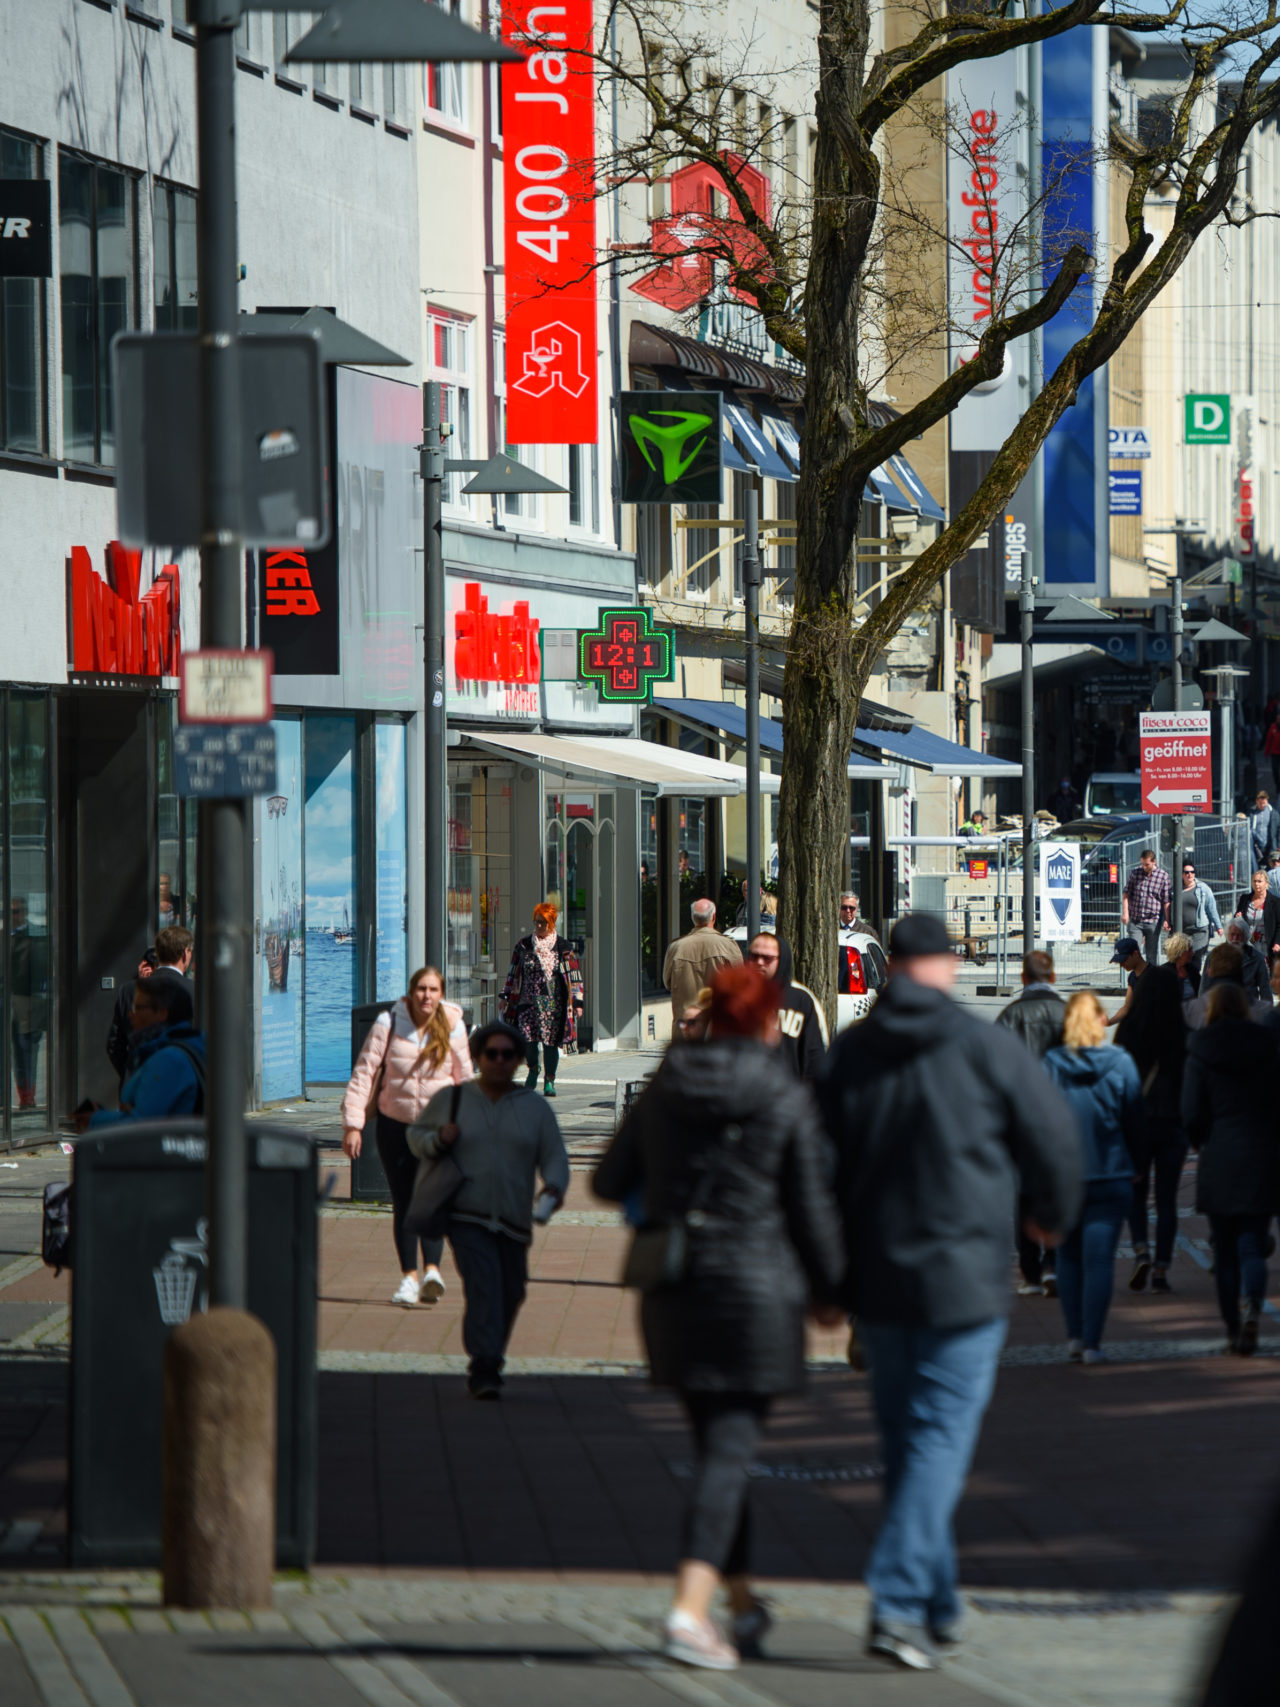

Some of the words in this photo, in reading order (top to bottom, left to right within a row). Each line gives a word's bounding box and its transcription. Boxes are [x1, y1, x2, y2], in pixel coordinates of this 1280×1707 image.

[510, 6, 569, 115] Jah
[515, 144, 569, 263] 400
[961, 109, 998, 322] vodafone
[0, 217, 31, 238] R
[1194, 401, 1224, 431] D
[1005, 522, 1026, 581] snipes
[1176, 717, 1208, 727] coco
[1144, 740, 1208, 762] geöffnet
[1048, 865, 1071, 880] MARE
